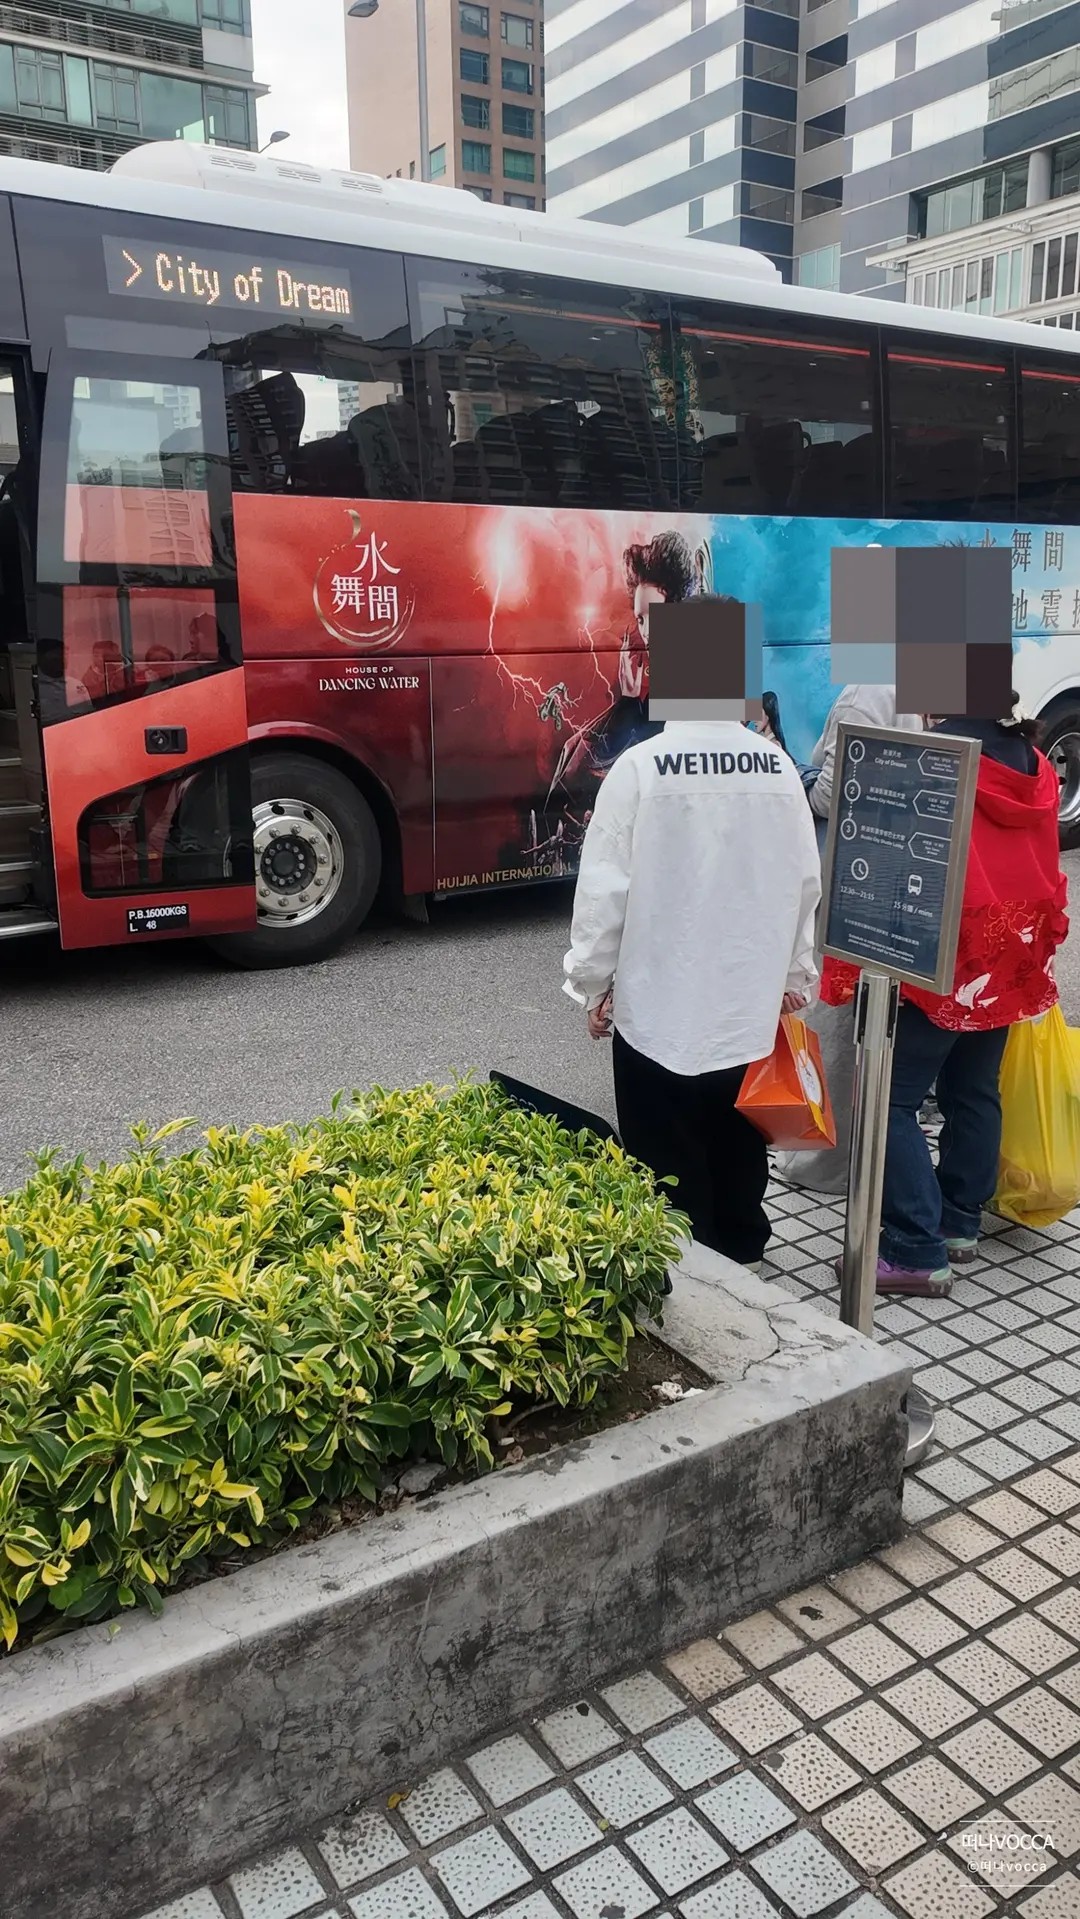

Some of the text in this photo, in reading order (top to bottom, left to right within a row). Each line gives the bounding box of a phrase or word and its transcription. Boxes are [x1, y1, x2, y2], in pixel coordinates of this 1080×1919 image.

[155, 252, 351, 314] City of Dream
[345, 666, 394, 674] HOUSE OF
[319, 676, 420, 691] DANCING WATER
[874, 757, 884, 766] City
[436, 862, 575, 890] HUIJIA INTERNATIONAL
[893, 901, 901, 909] 15
[918, 909, 933, 918] mins
[129, 920, 157, 932] L. 48
